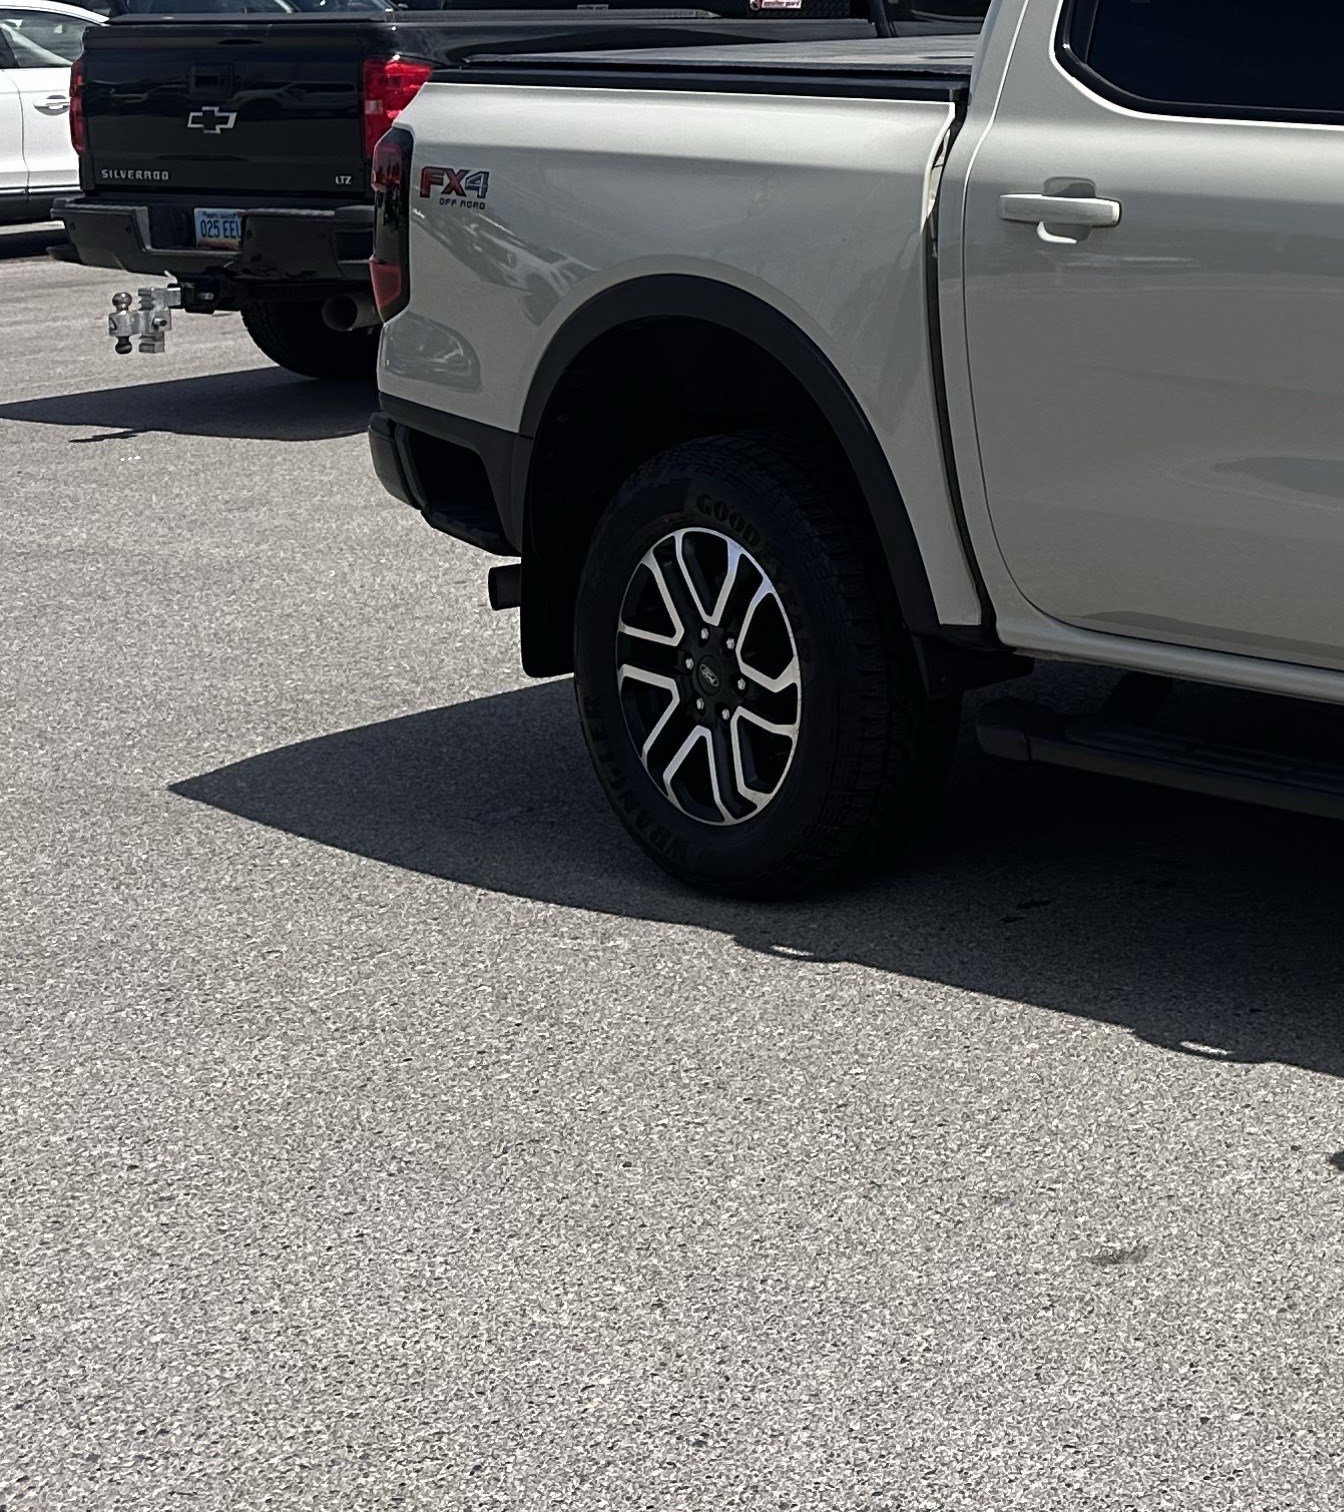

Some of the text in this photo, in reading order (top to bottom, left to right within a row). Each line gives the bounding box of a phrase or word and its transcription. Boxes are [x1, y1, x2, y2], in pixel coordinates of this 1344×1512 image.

[101, 168, 352, 186] SILVERADO LTZ
[419, 165, 490, 199] FX4
[439, 197, 486, 210] OFF ROAD
[200, 219, 220, 238] 025
